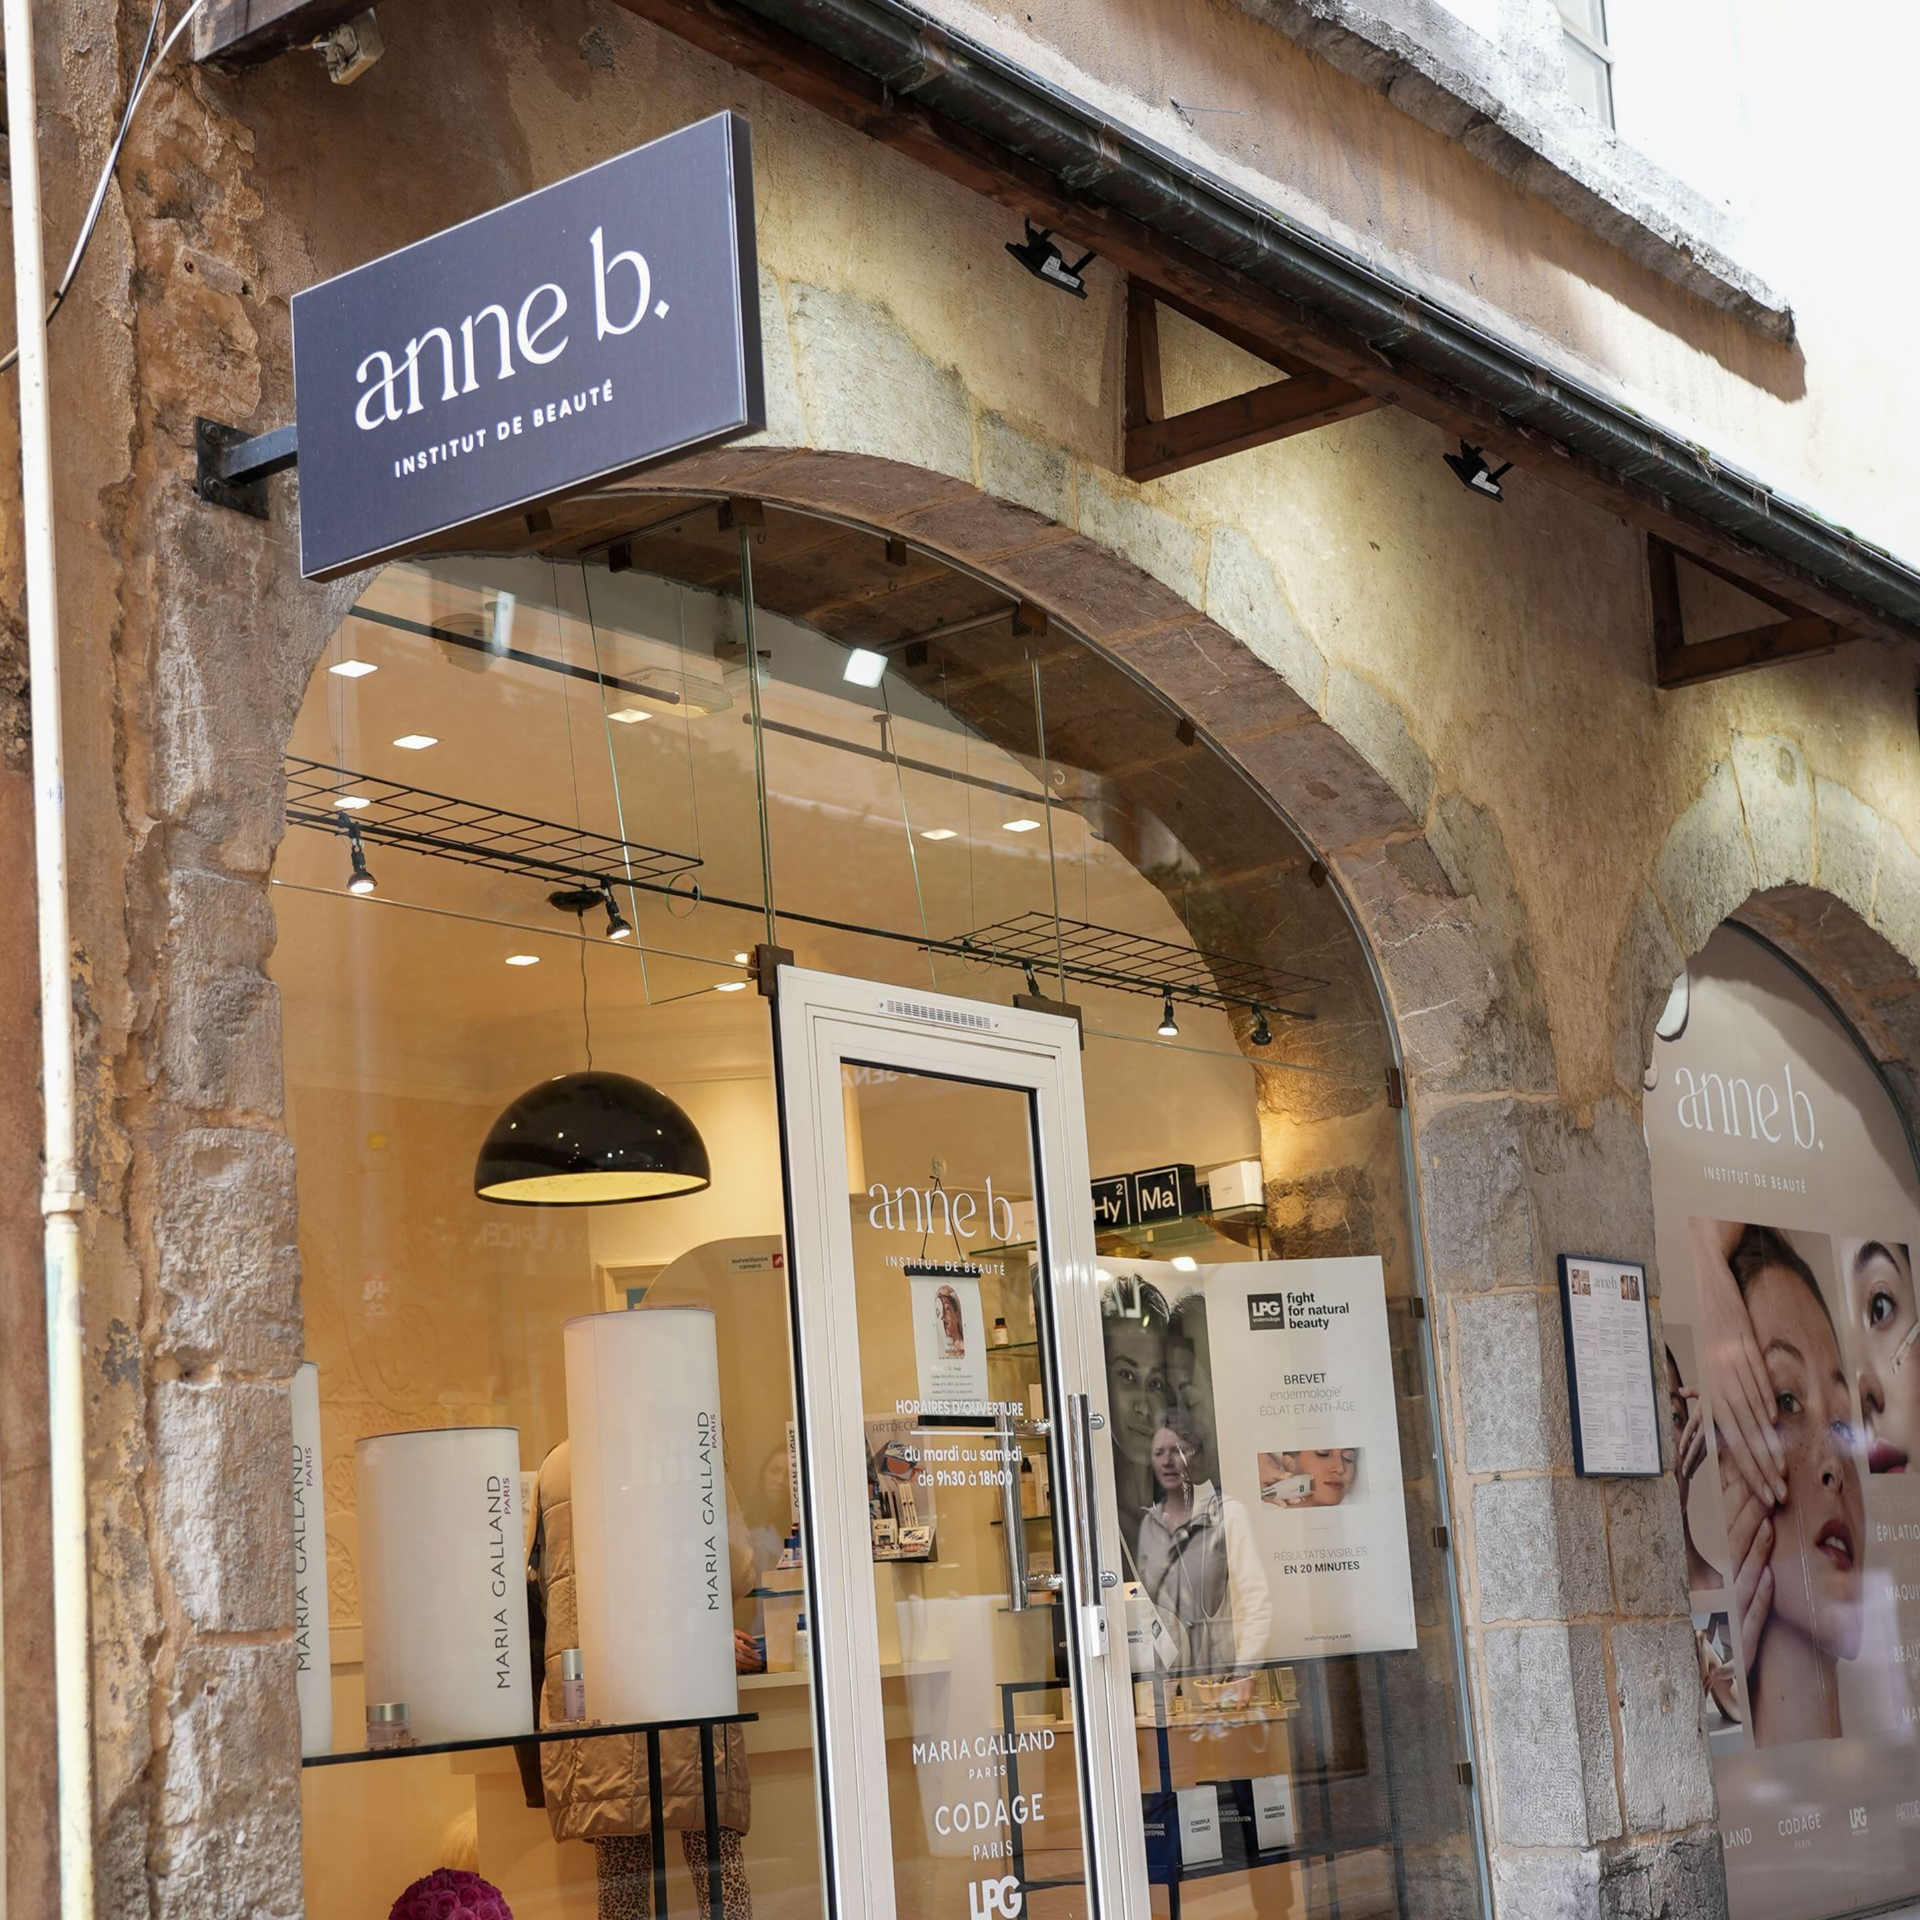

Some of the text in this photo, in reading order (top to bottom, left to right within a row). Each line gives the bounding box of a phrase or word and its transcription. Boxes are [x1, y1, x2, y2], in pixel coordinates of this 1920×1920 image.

[354, 226, 670, 431] anne b.
[394, 379, 614, 478] INSTITUT DE BEAUTÉ
[1675, 1062, 1824, 1151] anne b.
[1115, 1183, 1124, 1196] 2
[1168, 1173, 1175, 1186] 1
[1703, 1166, 1807, 1194] INSTITUT DE BEAUTÉ
[869, 1175, 1022, 1242] anne b.
[1141, 1186, 1176, 1212] Ma
[885, 1255, 1006, 1276] INSTITUT DE BEAUTÉ
[1251, 1301, 1281, 1317] LPG
[1286, 1292, 1315, 1306] fight
[1288, 1302, 1350, 1317] for natural
[1289, 1317, 1330, 1331] beauty
[1283, 1373, 1327, 1385] BREVET
[896, 1400, 1024, 1417] HORAIRES D'OUVERTURE
[1259, 1404, 1291, 1417] ÉCLAT
[1293, 1403, 1306, 1414] ET
[904, 1446, 1022, 1462] du mardi au samedi
[304, 1447, 313, 1487] PARIS
[917, 1470, 1013, 1487] de 9h30 à 18h00
[503, 1477, 511, 1515] PARIS
[697, 1411, 719, 1611] MARIA GALLAND
[1327, 1547, 1368, 1559] VISIBLES
[1284, 1561, 1360, 1575] EN 20 MINUTES
[487, 1475, 511, 1690] MARIA GALLAND
[295, 1586, 312, 1672] MARIA
[913, 1729, 1056, 1765] MARIA GALLAND
[968, 1765, 1007, 1780] PARIS
[935, 1793, 1045, 1836] CODAGE
[1778, 1813, 1822, 1837] CODAGE
[972, 1840, 1013, 1862] PARIS
[968, 1875, 1022, 1920] LPG
